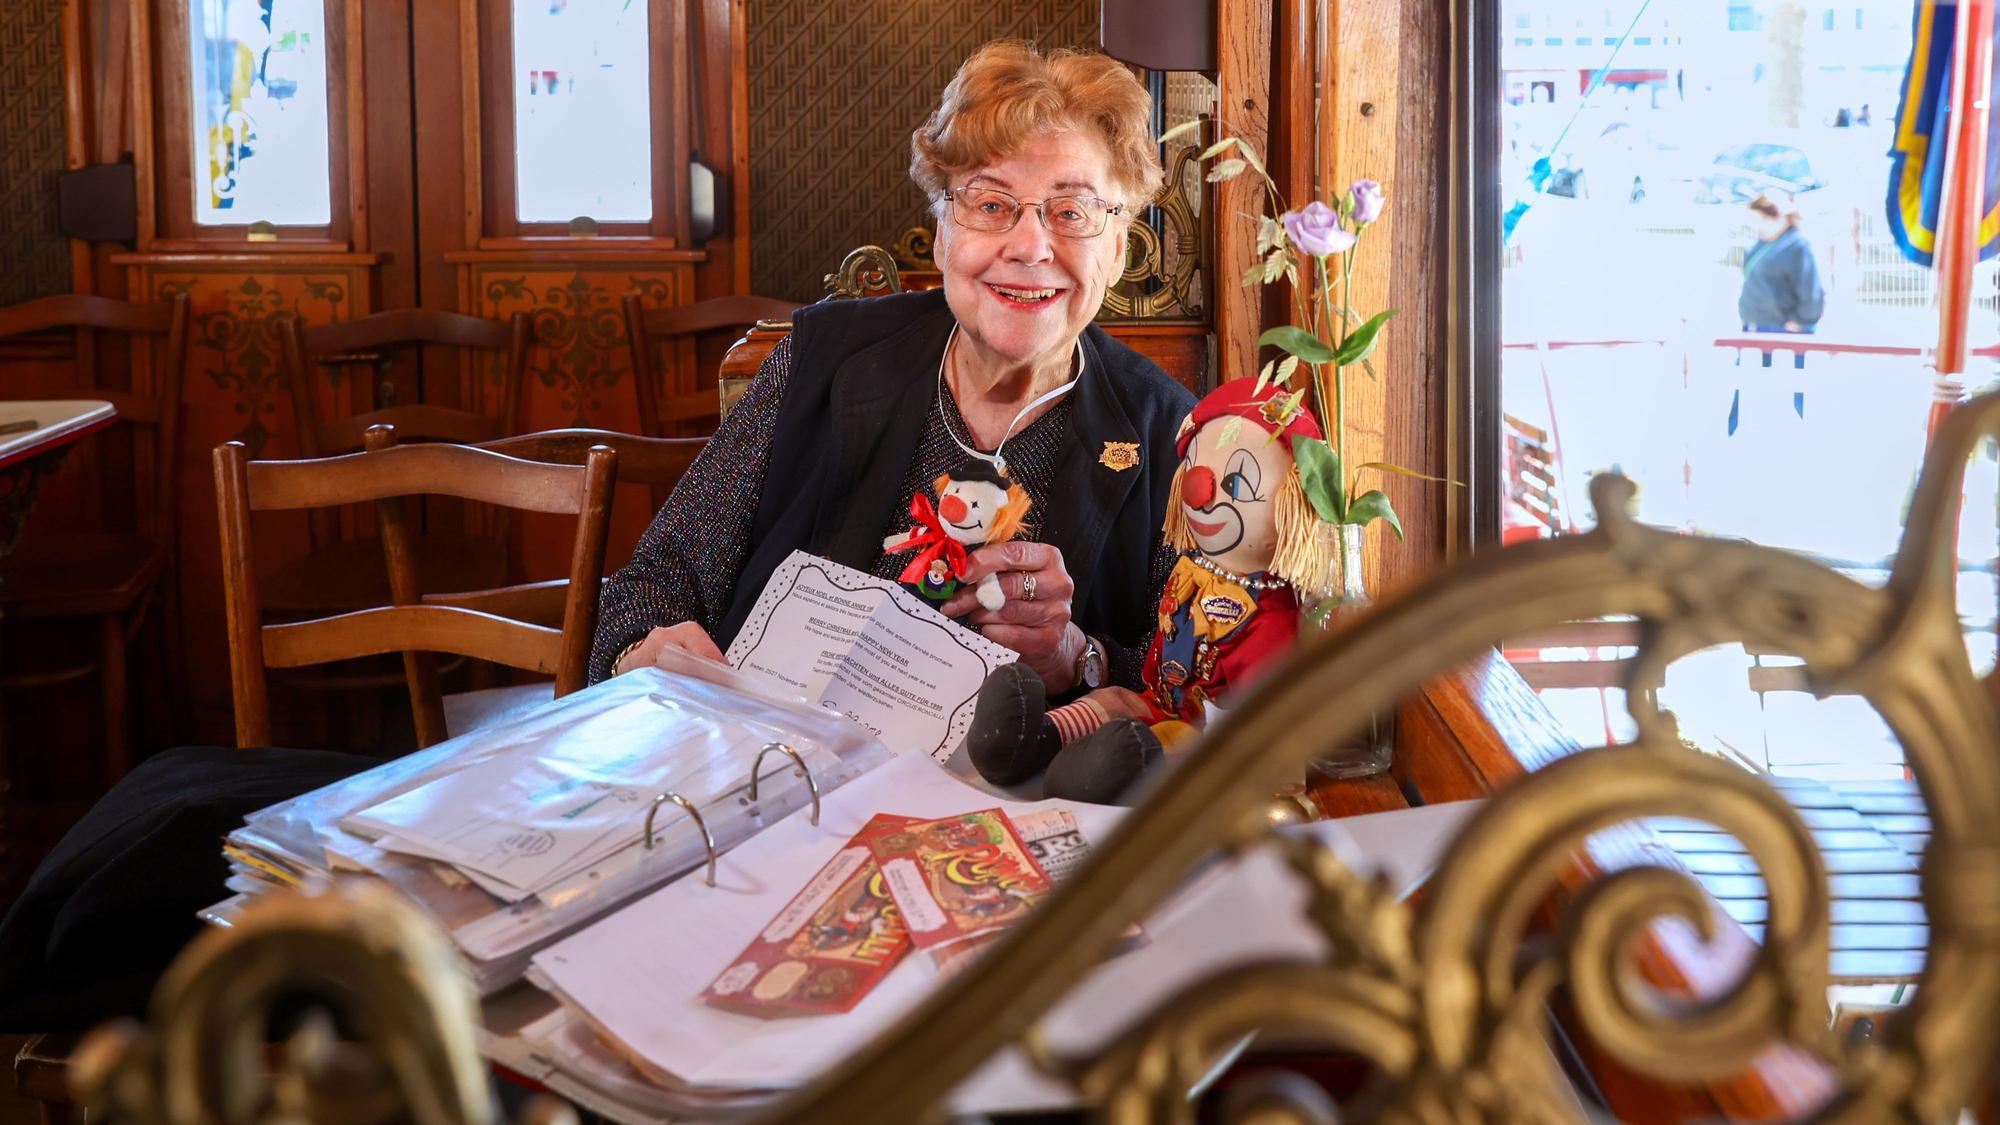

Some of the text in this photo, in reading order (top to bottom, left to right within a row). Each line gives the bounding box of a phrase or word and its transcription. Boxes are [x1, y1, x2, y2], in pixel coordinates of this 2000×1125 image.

[860, 631, 880, 648] HAPPY
[879, 644, 894, 658] NEW
[893, 653, 910, 667] YEAR
[880, 678, 900, 693] ALLES
[900, 688, 917, 701] GUTE
